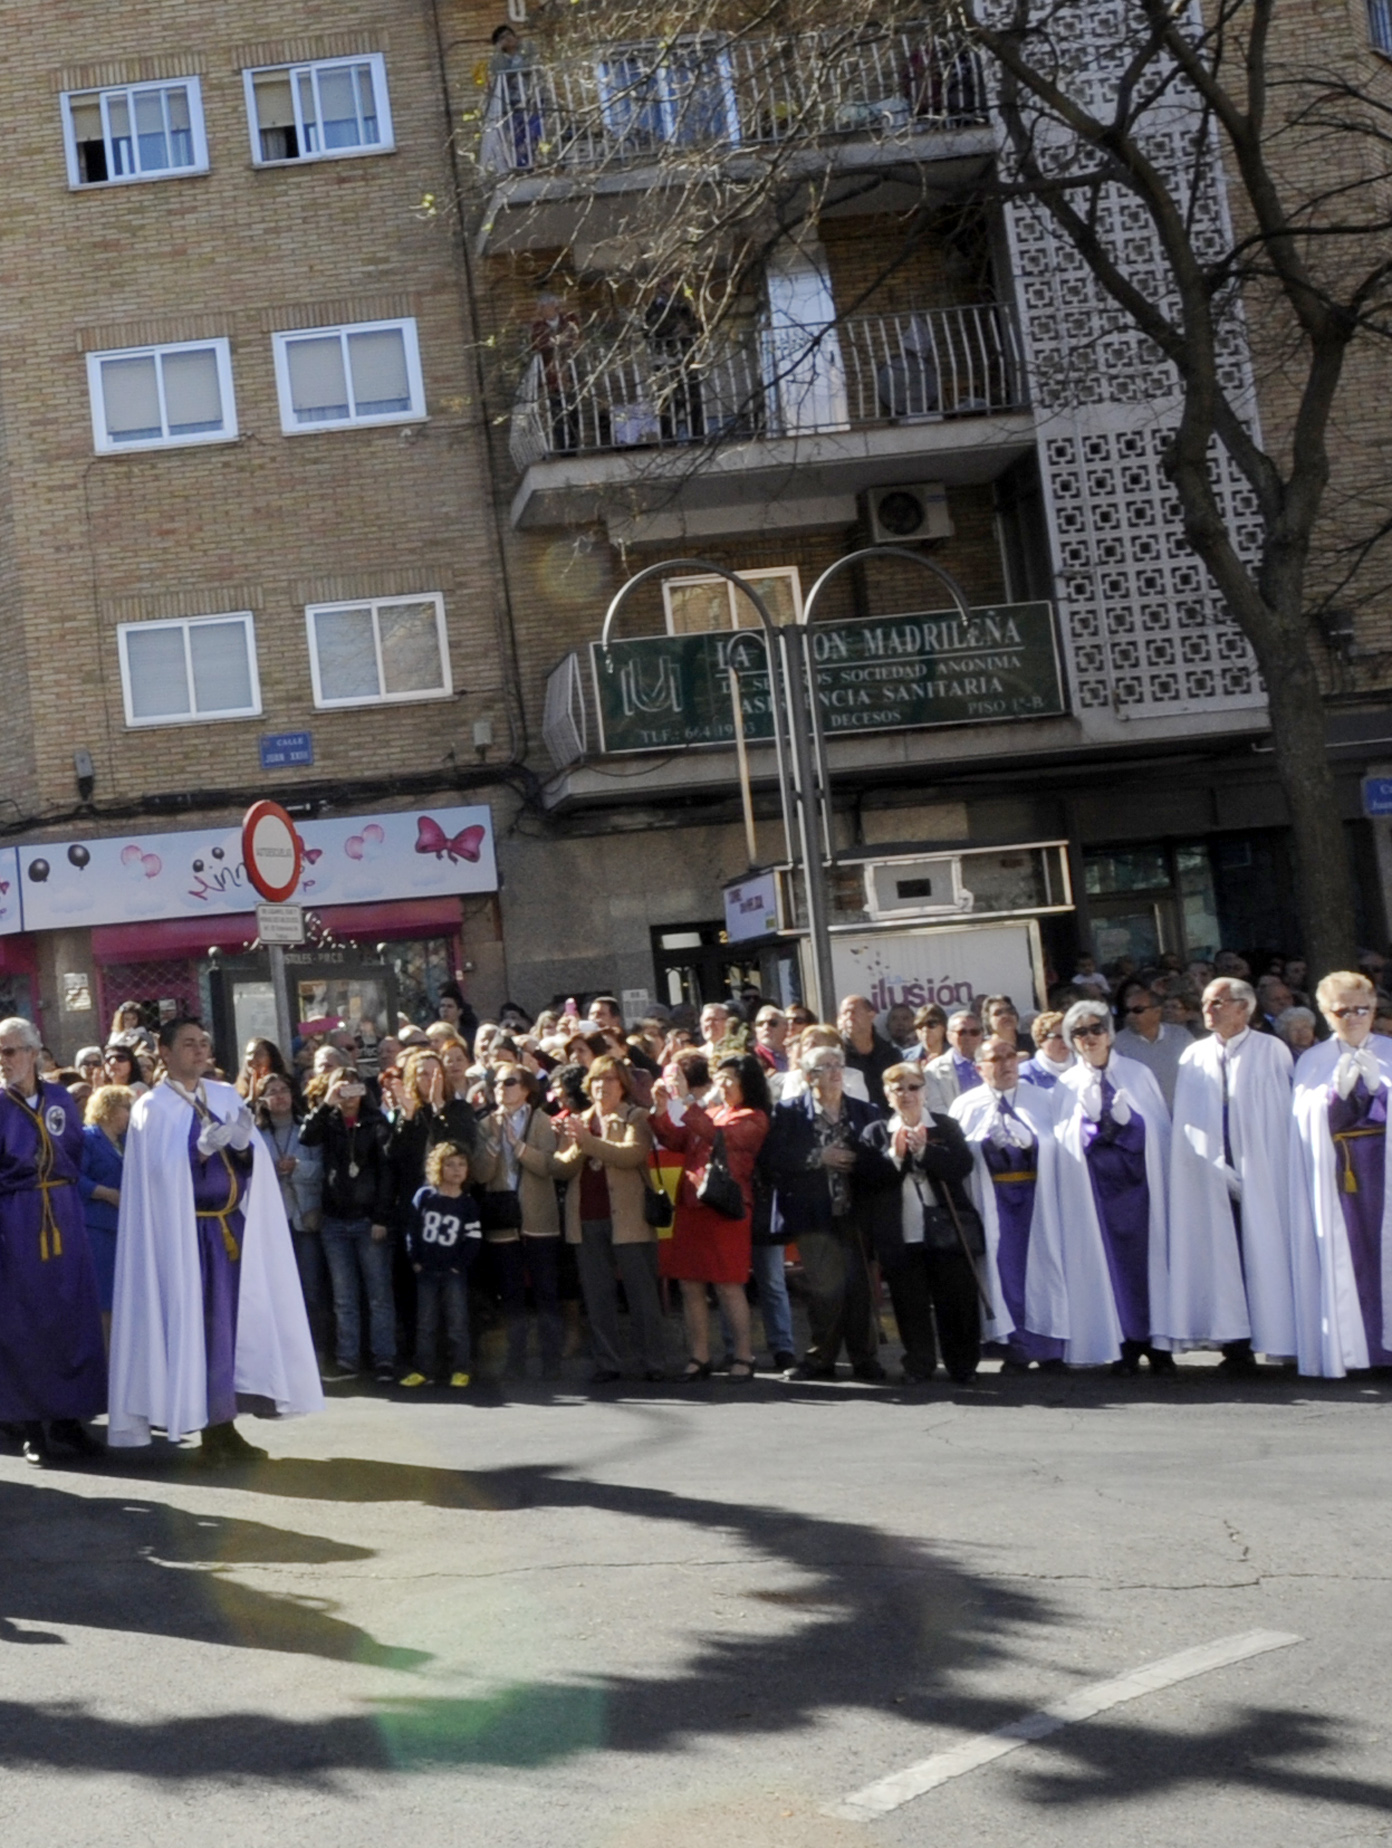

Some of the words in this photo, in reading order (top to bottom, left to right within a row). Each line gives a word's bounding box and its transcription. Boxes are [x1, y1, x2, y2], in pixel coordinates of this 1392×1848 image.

[716, 641, 751, 669] LA
[862, 611, 1022, 658] MADRILEÑA
[840, 663, 927, 685] SOCIEDAD
[937, 655, 1021, 675] ANONIMA
[882, 676, 1004, 703] SANITARIA
[831, 709, 902, 728] DECESOS
[968, 698, 1006, 715] PISO
[276, 736, 304, 747] CALLE
[871, 975, 974, 1013] ilusión
[423, 1211, 460, 1247] 83
